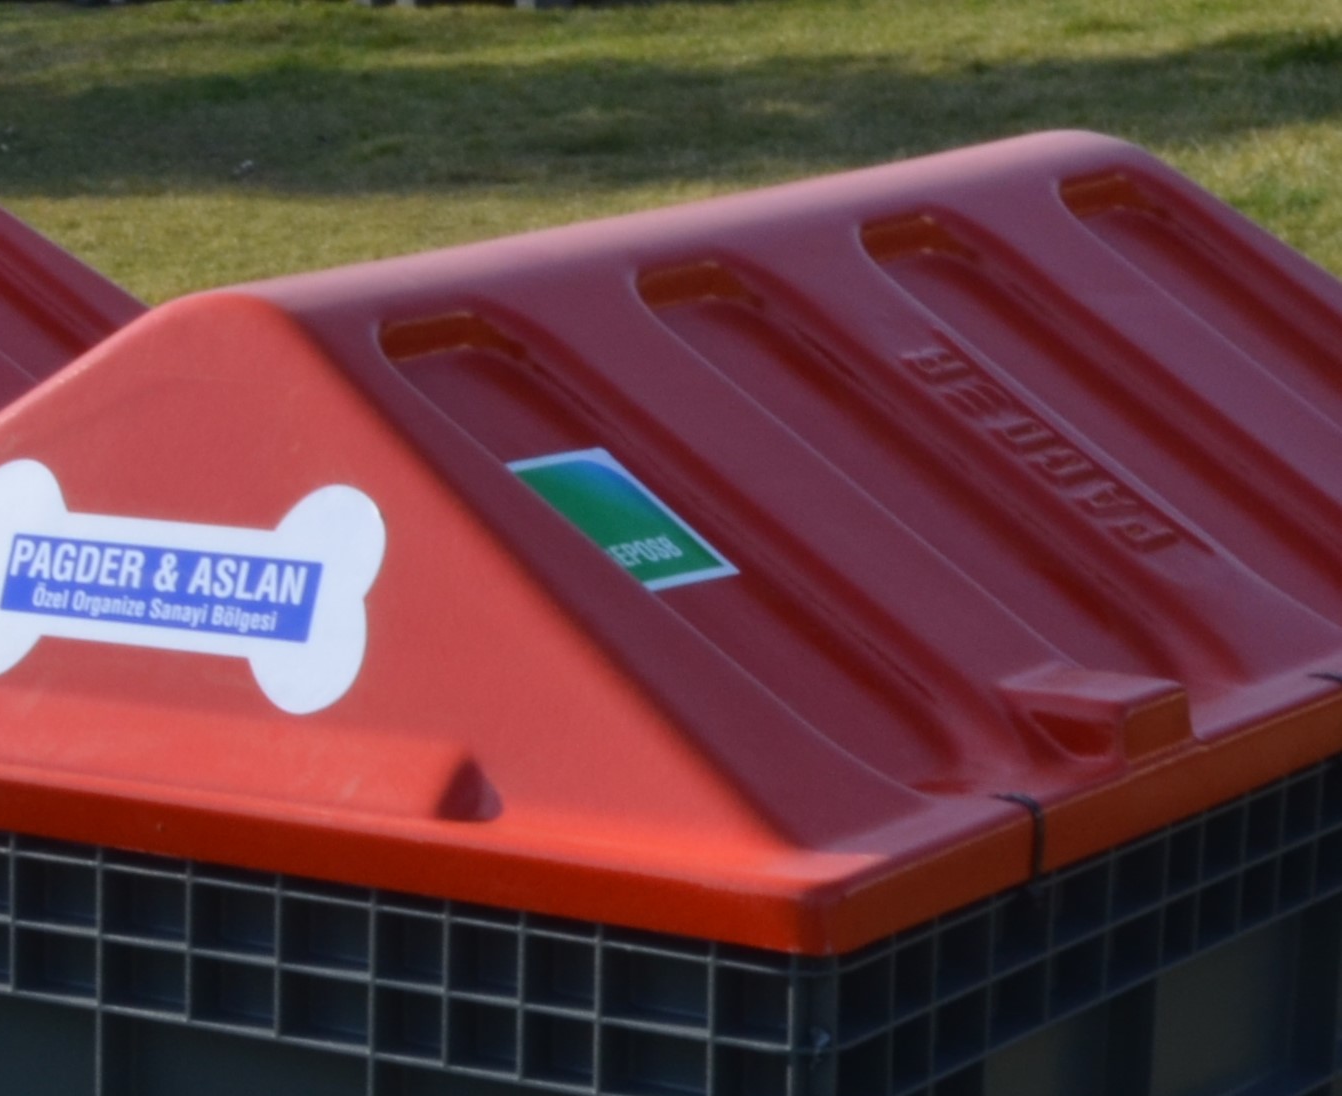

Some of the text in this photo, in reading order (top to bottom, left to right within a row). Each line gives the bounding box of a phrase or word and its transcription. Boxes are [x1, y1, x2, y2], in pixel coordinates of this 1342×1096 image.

[11, 539, 308, 606] PAGDER & ASLAN
[32, 582, 278, 633] Özel Organize Sanayi Bölgesi
